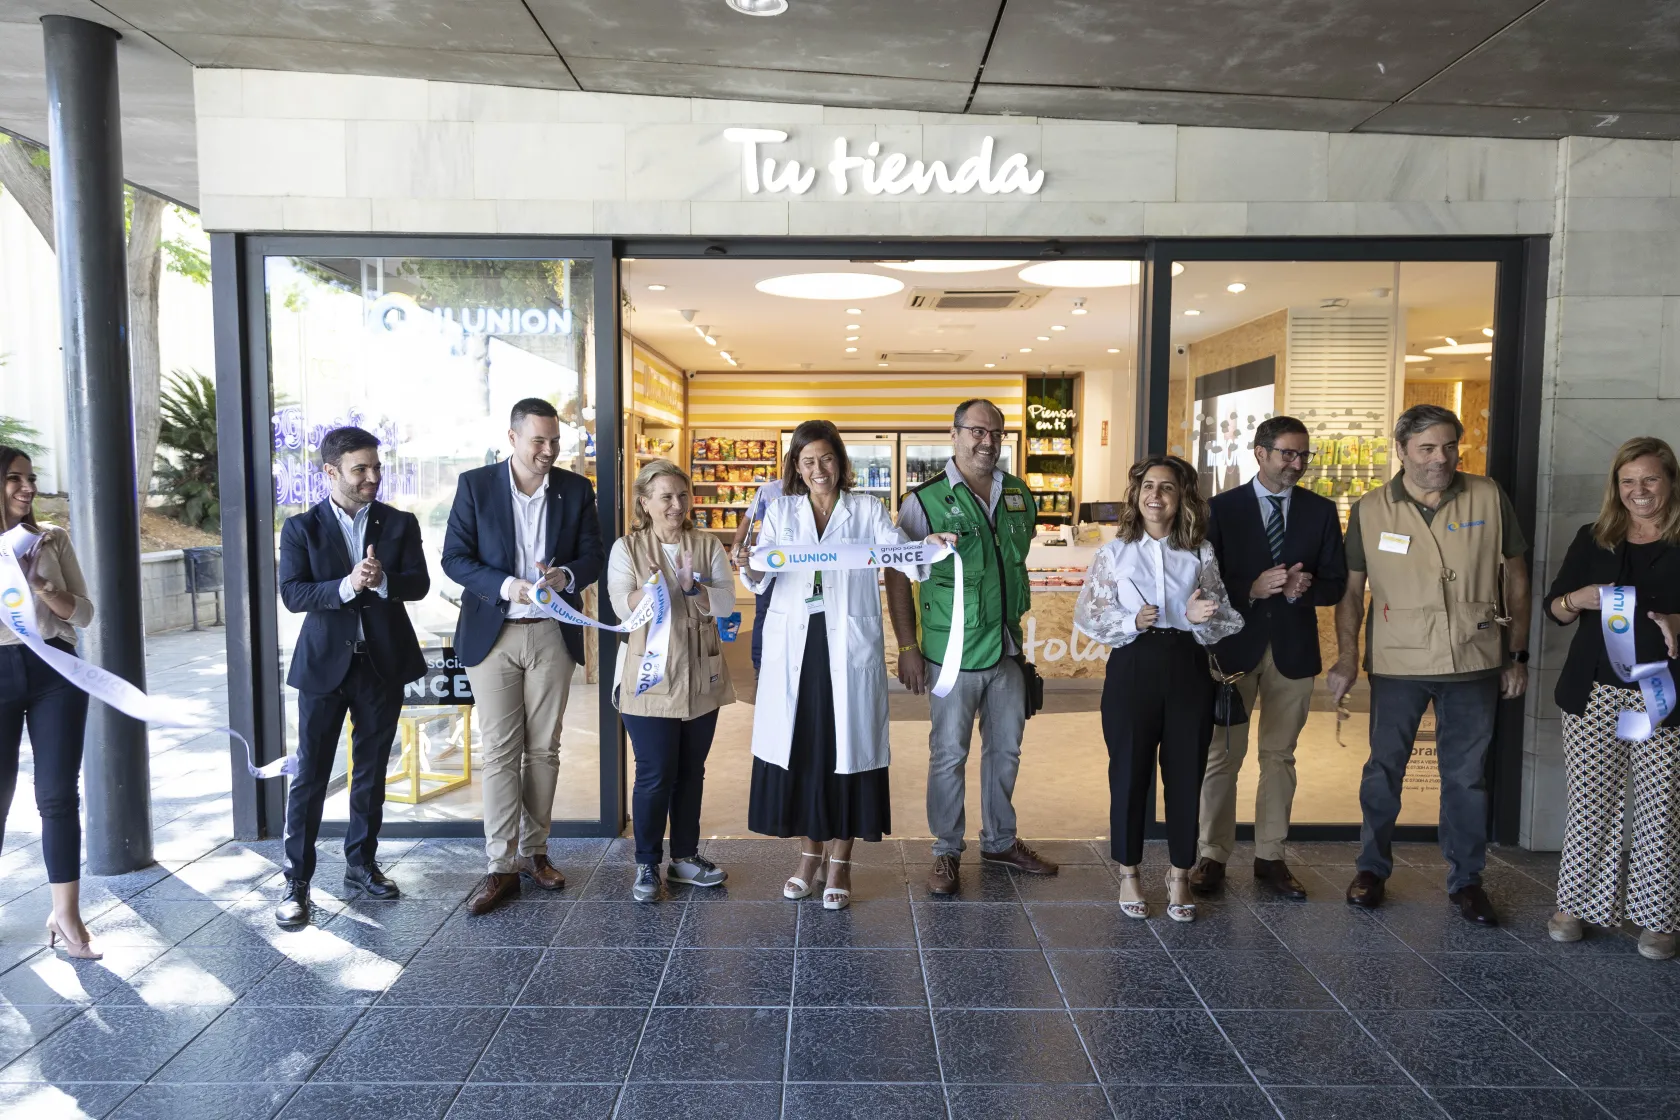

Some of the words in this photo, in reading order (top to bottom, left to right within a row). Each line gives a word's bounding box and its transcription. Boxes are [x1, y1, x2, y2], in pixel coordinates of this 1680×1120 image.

[723, 128, 815, 194] Tu
[828, 136, 1044, 194] tienda
[1028, 404, 1076, 419] Piensa
[1035, 421, 1052, 430] en
[789, 553, 837, 563] ILUNION
[881, 551, 923, 564] ONCE
